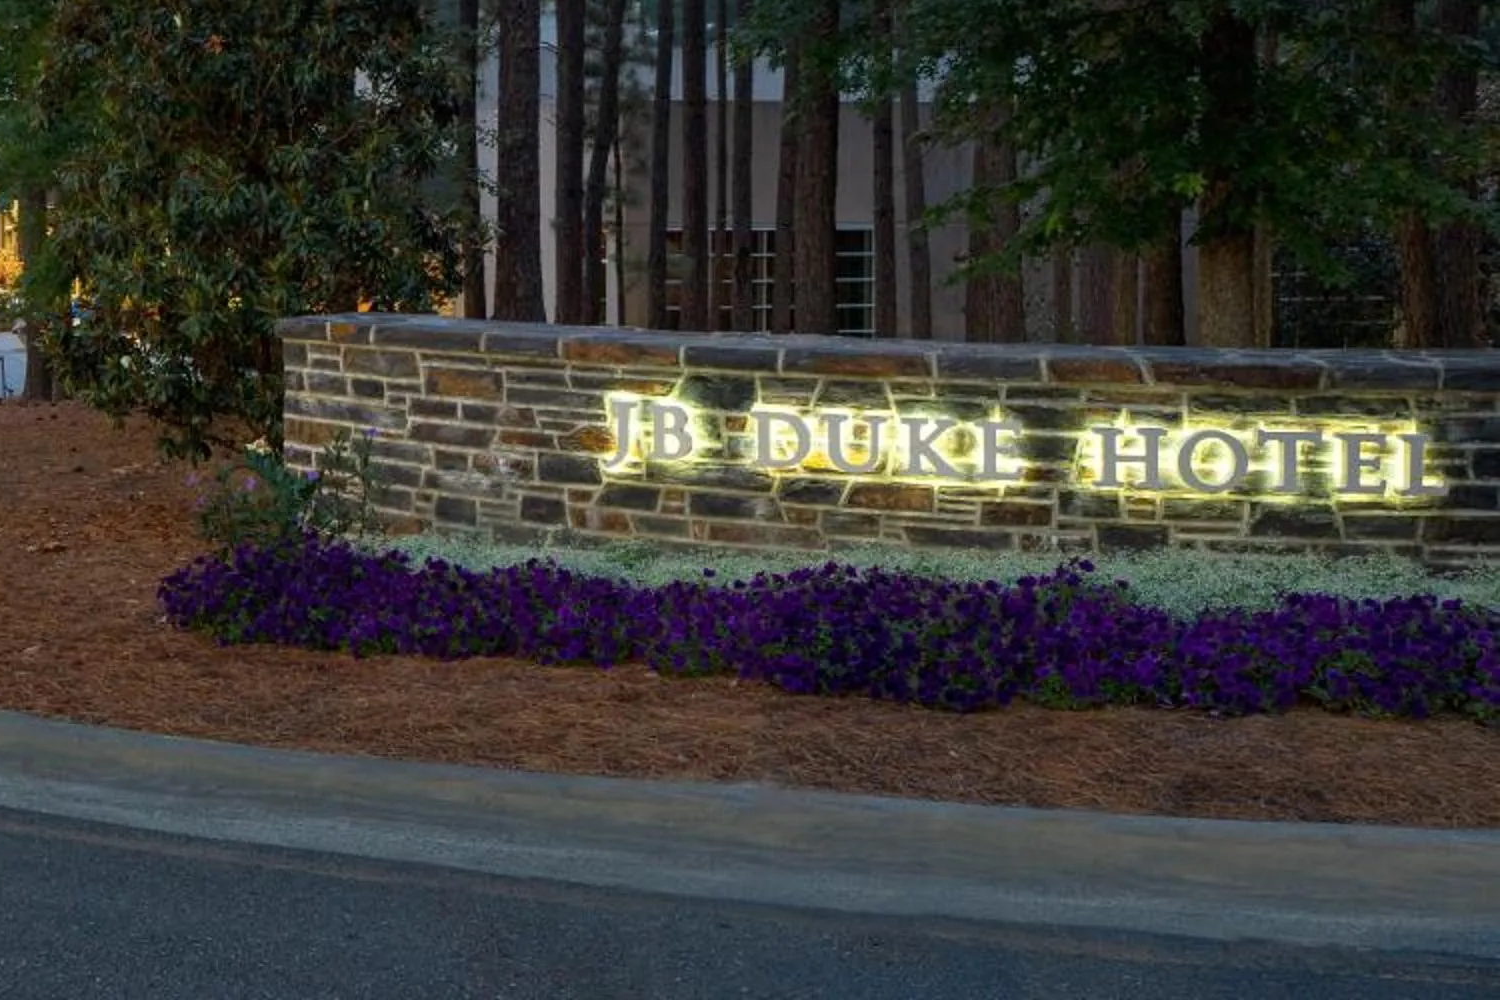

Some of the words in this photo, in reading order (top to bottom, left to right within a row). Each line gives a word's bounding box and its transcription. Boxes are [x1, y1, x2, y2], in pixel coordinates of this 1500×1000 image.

[604, 401, 693, 468] JB
[751, 410, 1023, 480] DUKE
[1091, 427, 1449, 496] HOTEL
